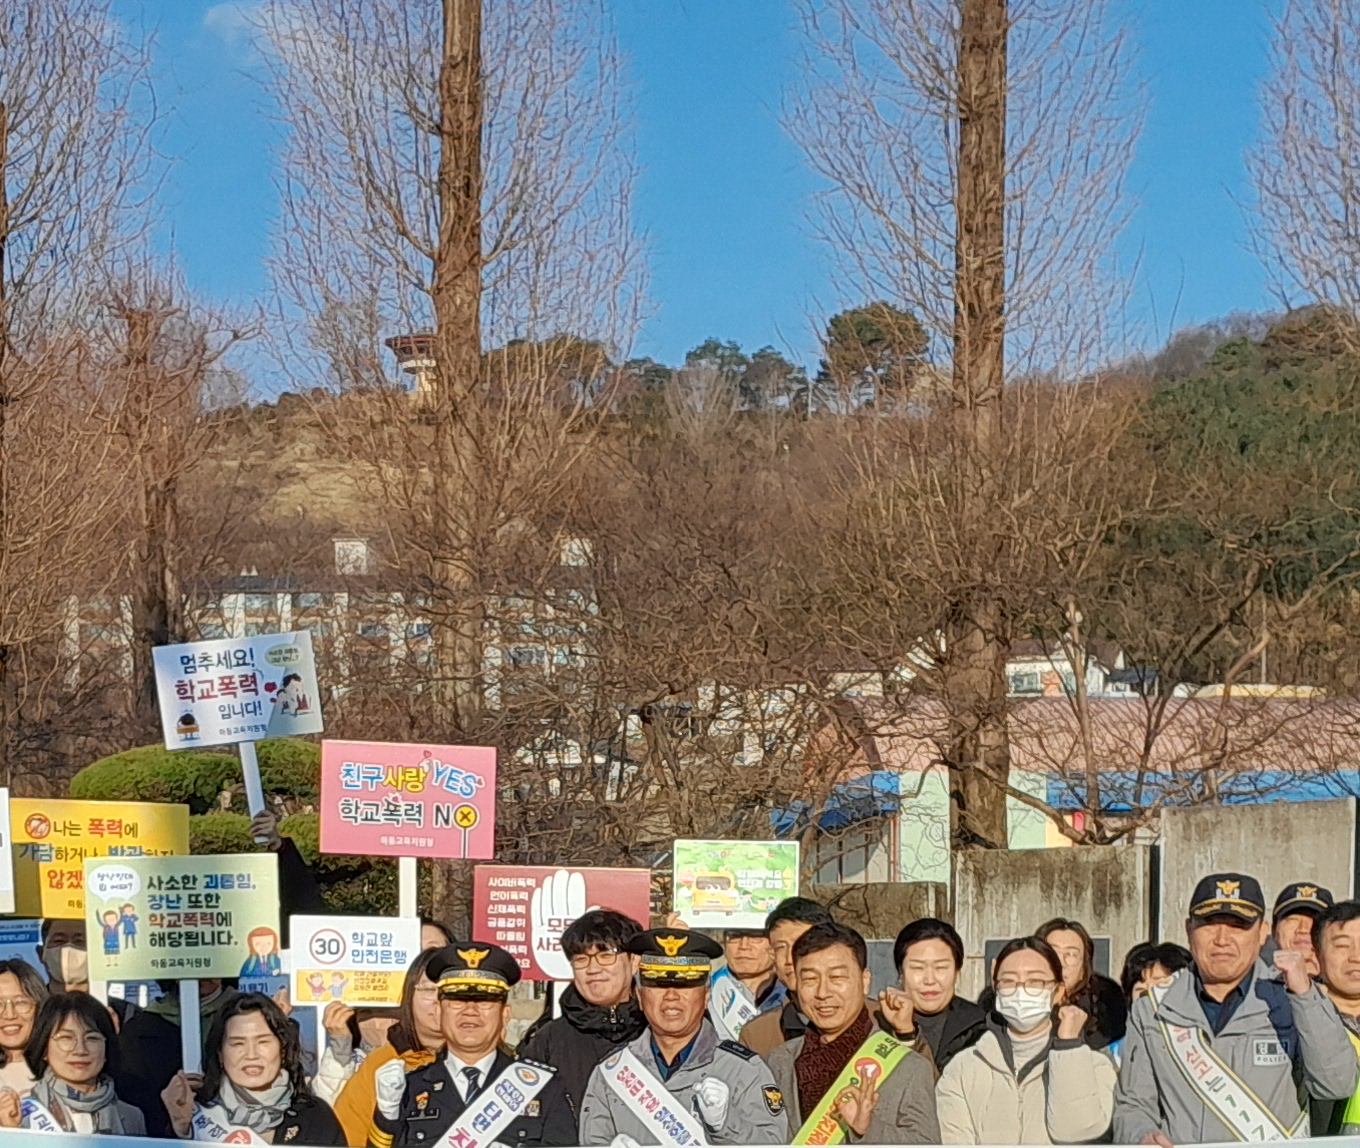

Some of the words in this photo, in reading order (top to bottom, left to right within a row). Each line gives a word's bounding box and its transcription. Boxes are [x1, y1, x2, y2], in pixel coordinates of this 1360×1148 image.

[180, 648, 256, 675] 멈추세요!
[175, 672, 260, 703] 학교폭력
[218, 701, 263, 720] 입니다!
[433, 761, 477, 797] YES
[340, 800, 423, 827] 학교폭력
[53, 821, 82, 837] 나는
[88, 818, 138, 838] 폭력에
[147, 873, 198, 892] 사소한
[488, 877, 536, 888] 사이버폭력
[148, 894, 183, 911] 장난
[186, 893, 221, 910] 또한
[487, 904, 526, 914] 신체폭력
[148, 912, 233, 930] 학교폭력에
[148, 930, 239, 948] 해당됩니다.
[315, 938, 340, 955] 30
[151, 957, 211, 969] 하동교육지원청
[352, 949, 407, 965] 안전운행
[472, 1101, 503, 1134] 타면
